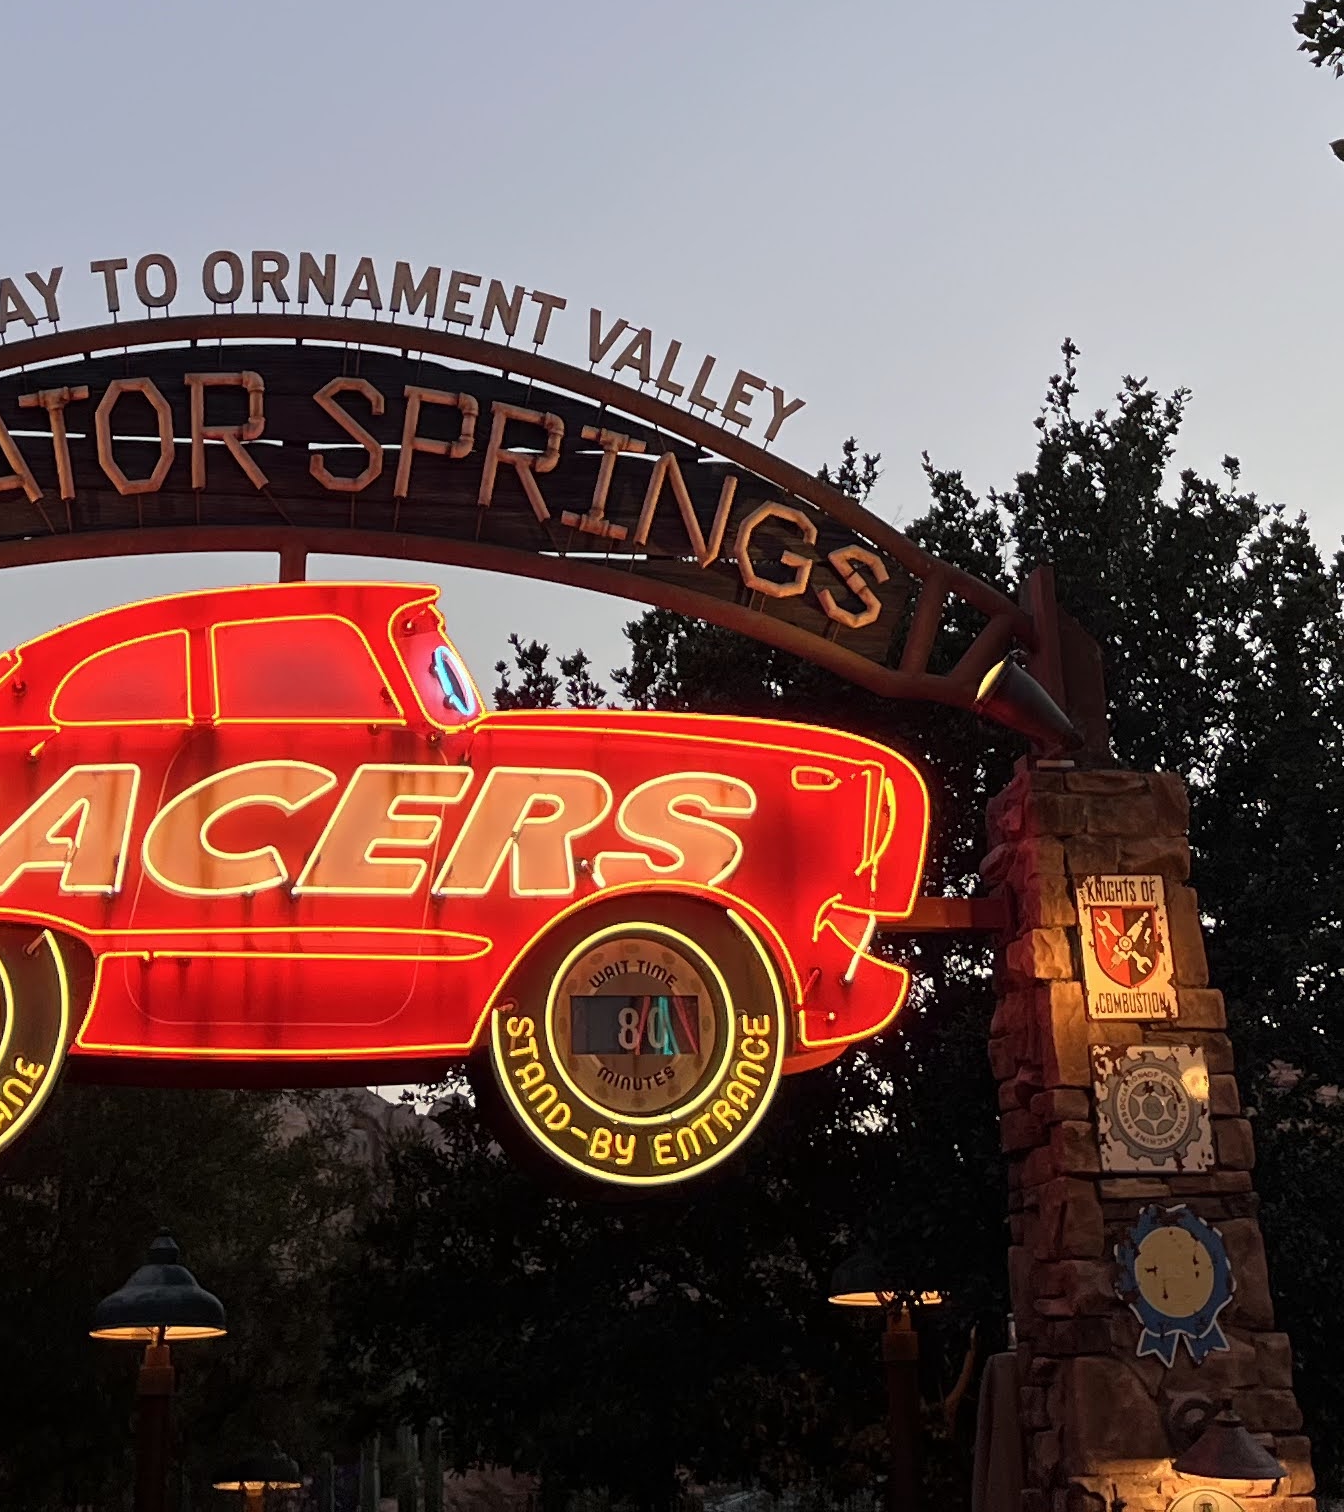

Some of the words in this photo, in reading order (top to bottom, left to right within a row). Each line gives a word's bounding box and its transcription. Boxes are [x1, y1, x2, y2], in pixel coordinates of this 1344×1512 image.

[91, 252, 178, 311] TO
[201, 248, 567, 346] ORNAMENT
[586, 306, 806, 442] VALLEY
[309, 375, 892, 630] SPRINGS
[1086, 879, 1136, 903] KNIGHTS
[1141, 879, 1157, 902] OF
[588, 959, 631, 989] WAIT
[636, 959, 679, 989] TIME
[1098, 991, 1167, 1015] COMBUSTION
[506, 1015, 637, 1166] STAND-BY
[652, 1013, 772, 1166] ENTRANCE
[596, 1065, 676, 1092] MINUTES
